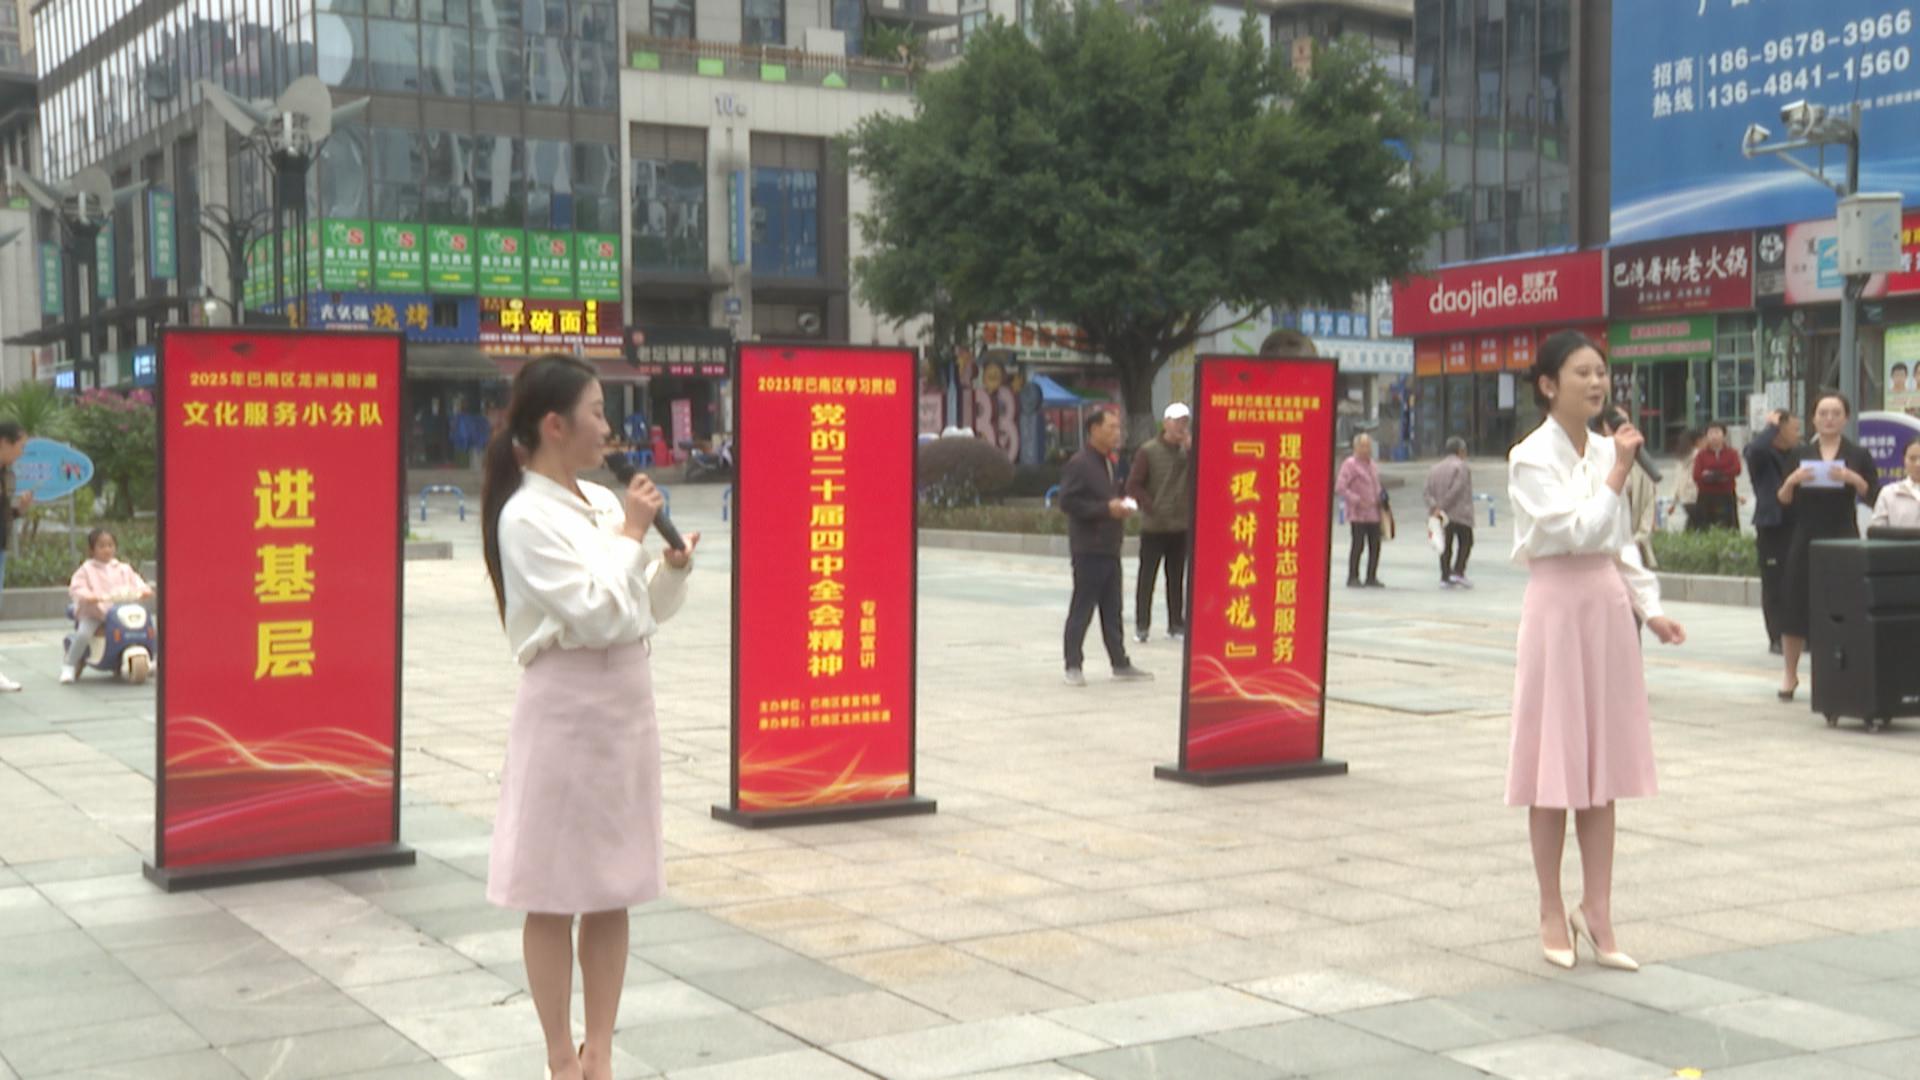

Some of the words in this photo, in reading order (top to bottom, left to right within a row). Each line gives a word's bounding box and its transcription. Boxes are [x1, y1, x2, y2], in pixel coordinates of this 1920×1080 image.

[1708, 10, 1912, 75] 186-9678-3966
[1653, 57, 1693, 88] 招商
[1707, 47, 1909, 108] 136-4841-1560
[1653, 87, 1693, 118] 热线
[1429, 276, 1558, 317] daojiale.com
[1521, 271, 1557, 289] 到家了
[372, 301, 430, 331] 烧烤
[500, 309, 582, 335] 呼碗面
[758, 376, 897, 395] 2025年巴南区学习贯彻
[183, 402, 384, 427] 文化服务小分队
[808, 403, 846, 678] 党的二十届四中全会精神
[1272, 433, 1302, 664] 理论宣讲志愿服务
[254, 469, 316, 681] 进基层
[859, 600, 876, 669] 专题宣讲
